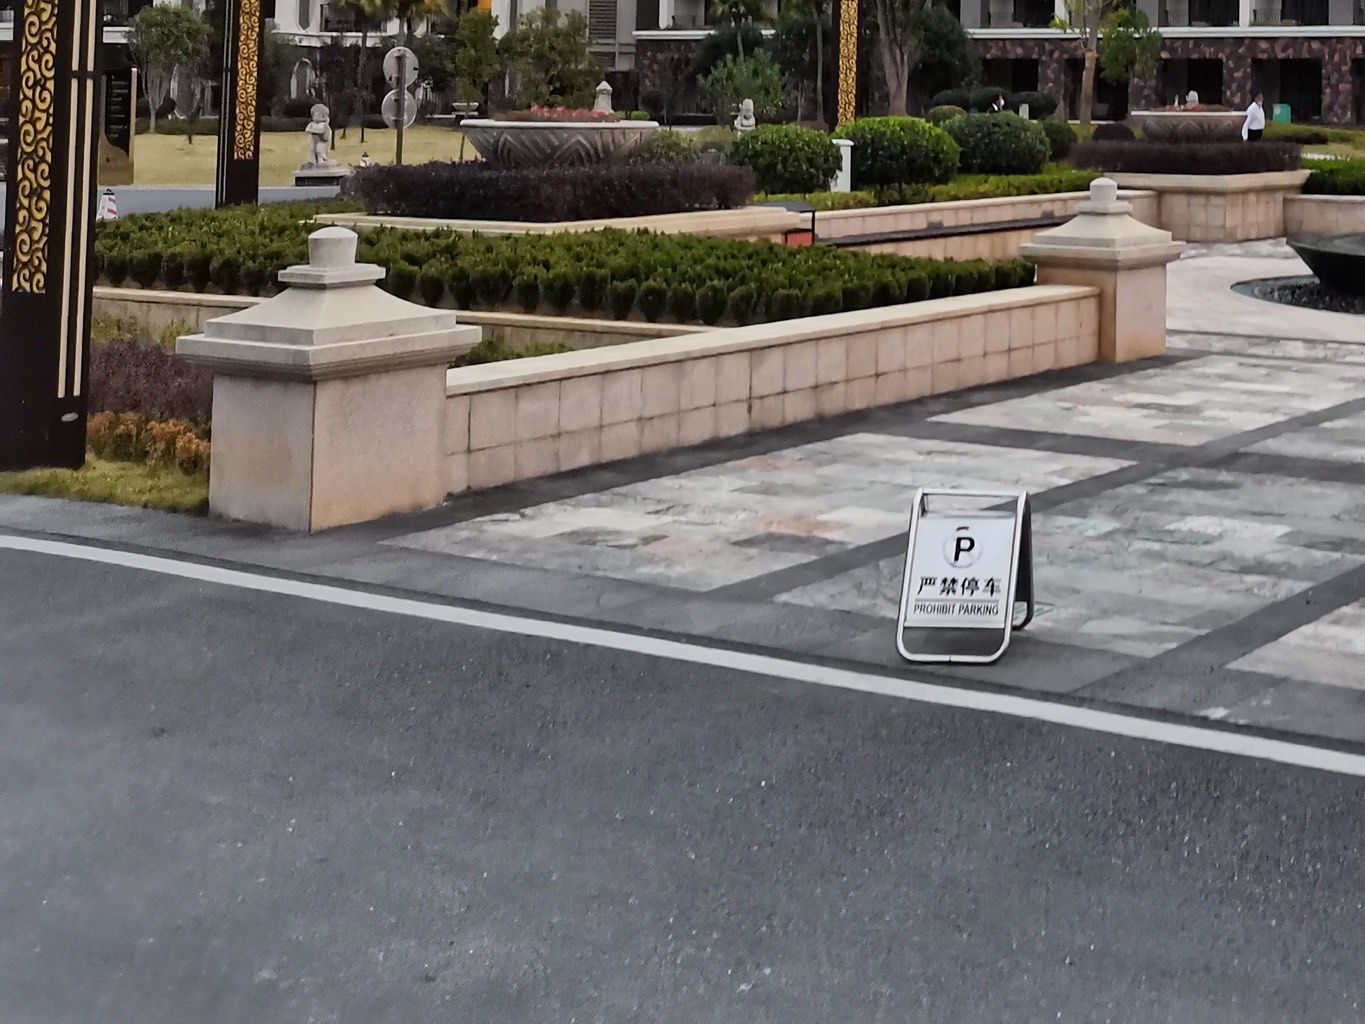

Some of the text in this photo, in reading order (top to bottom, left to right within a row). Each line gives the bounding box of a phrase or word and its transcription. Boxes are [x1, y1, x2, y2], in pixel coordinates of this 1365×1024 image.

[953, 536, 976, 562] P
[913, 603, 999, 616] PROHIBIT PARKING
